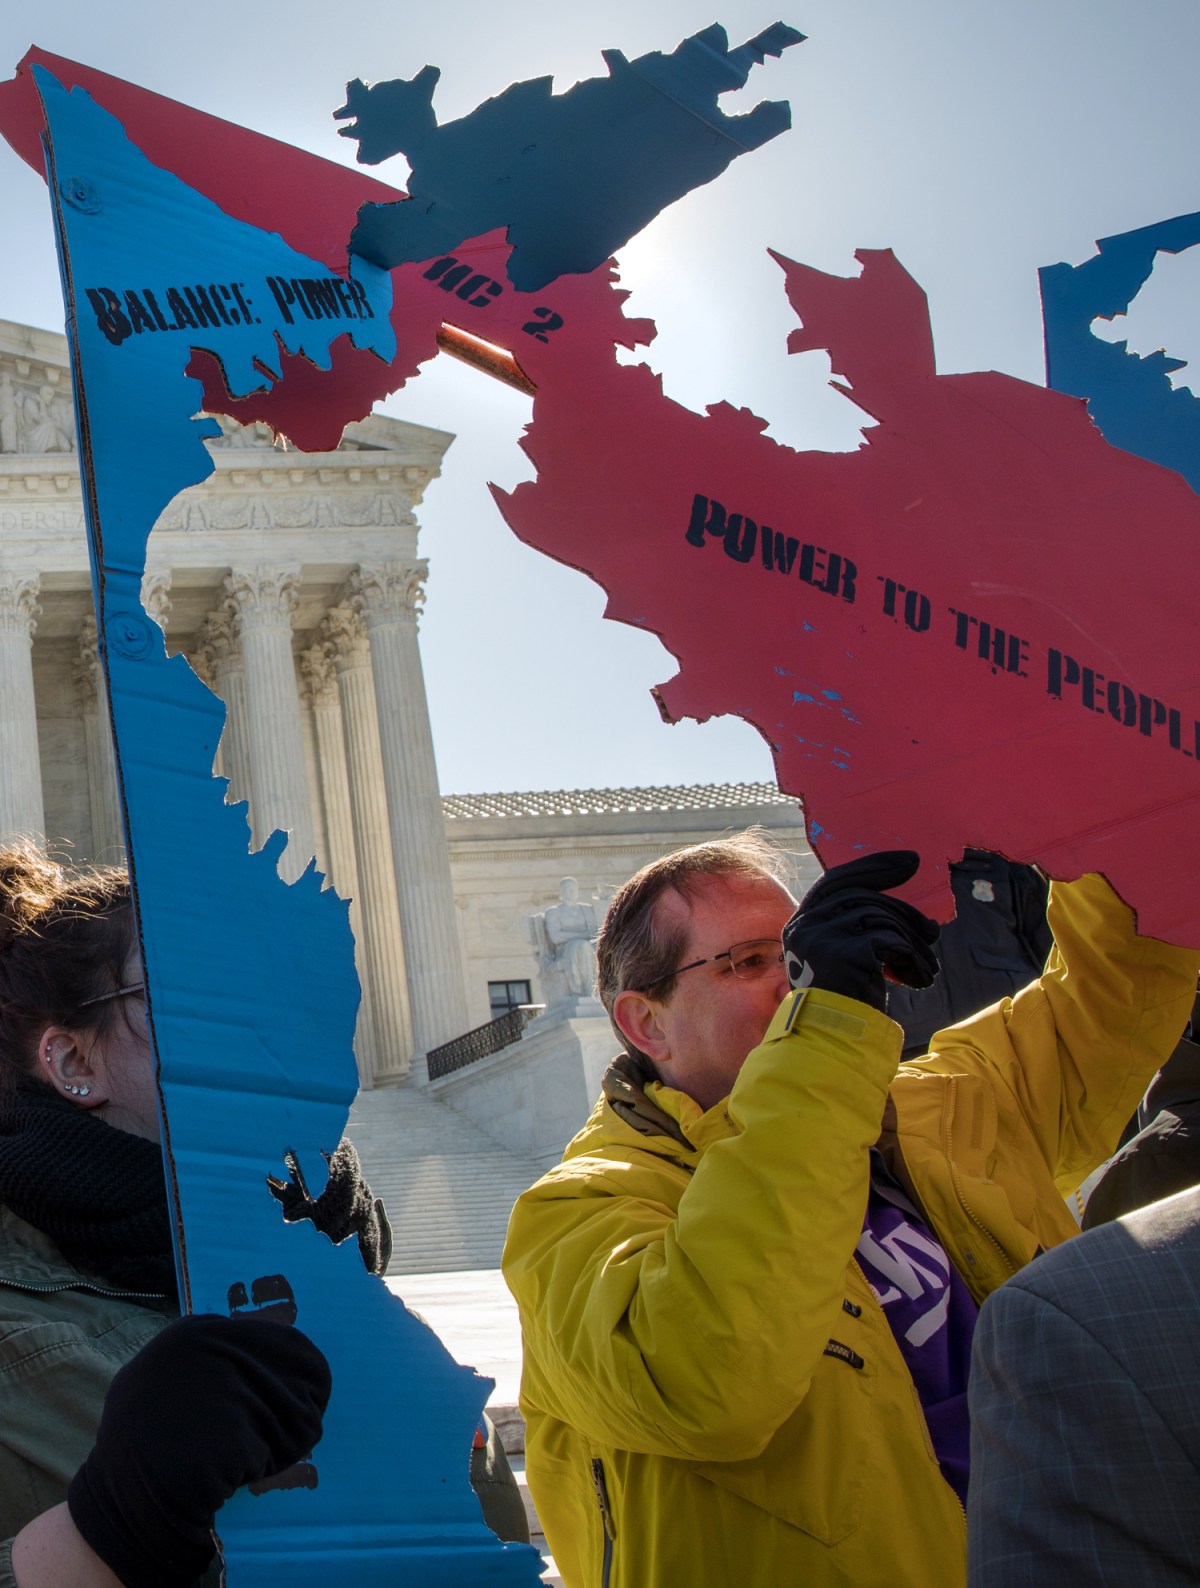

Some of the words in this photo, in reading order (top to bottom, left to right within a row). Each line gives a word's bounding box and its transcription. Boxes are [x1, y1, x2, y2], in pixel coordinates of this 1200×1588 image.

[85, 283, 261, 346] BALANCE
[521, 307, 564, 343] 2
[684, 494, 857, 604] POWER
[876, 576, 931, 633] TO
[948, 607, 1029, 677] THE
[1047, 648, 1200, 761] PEOPL
